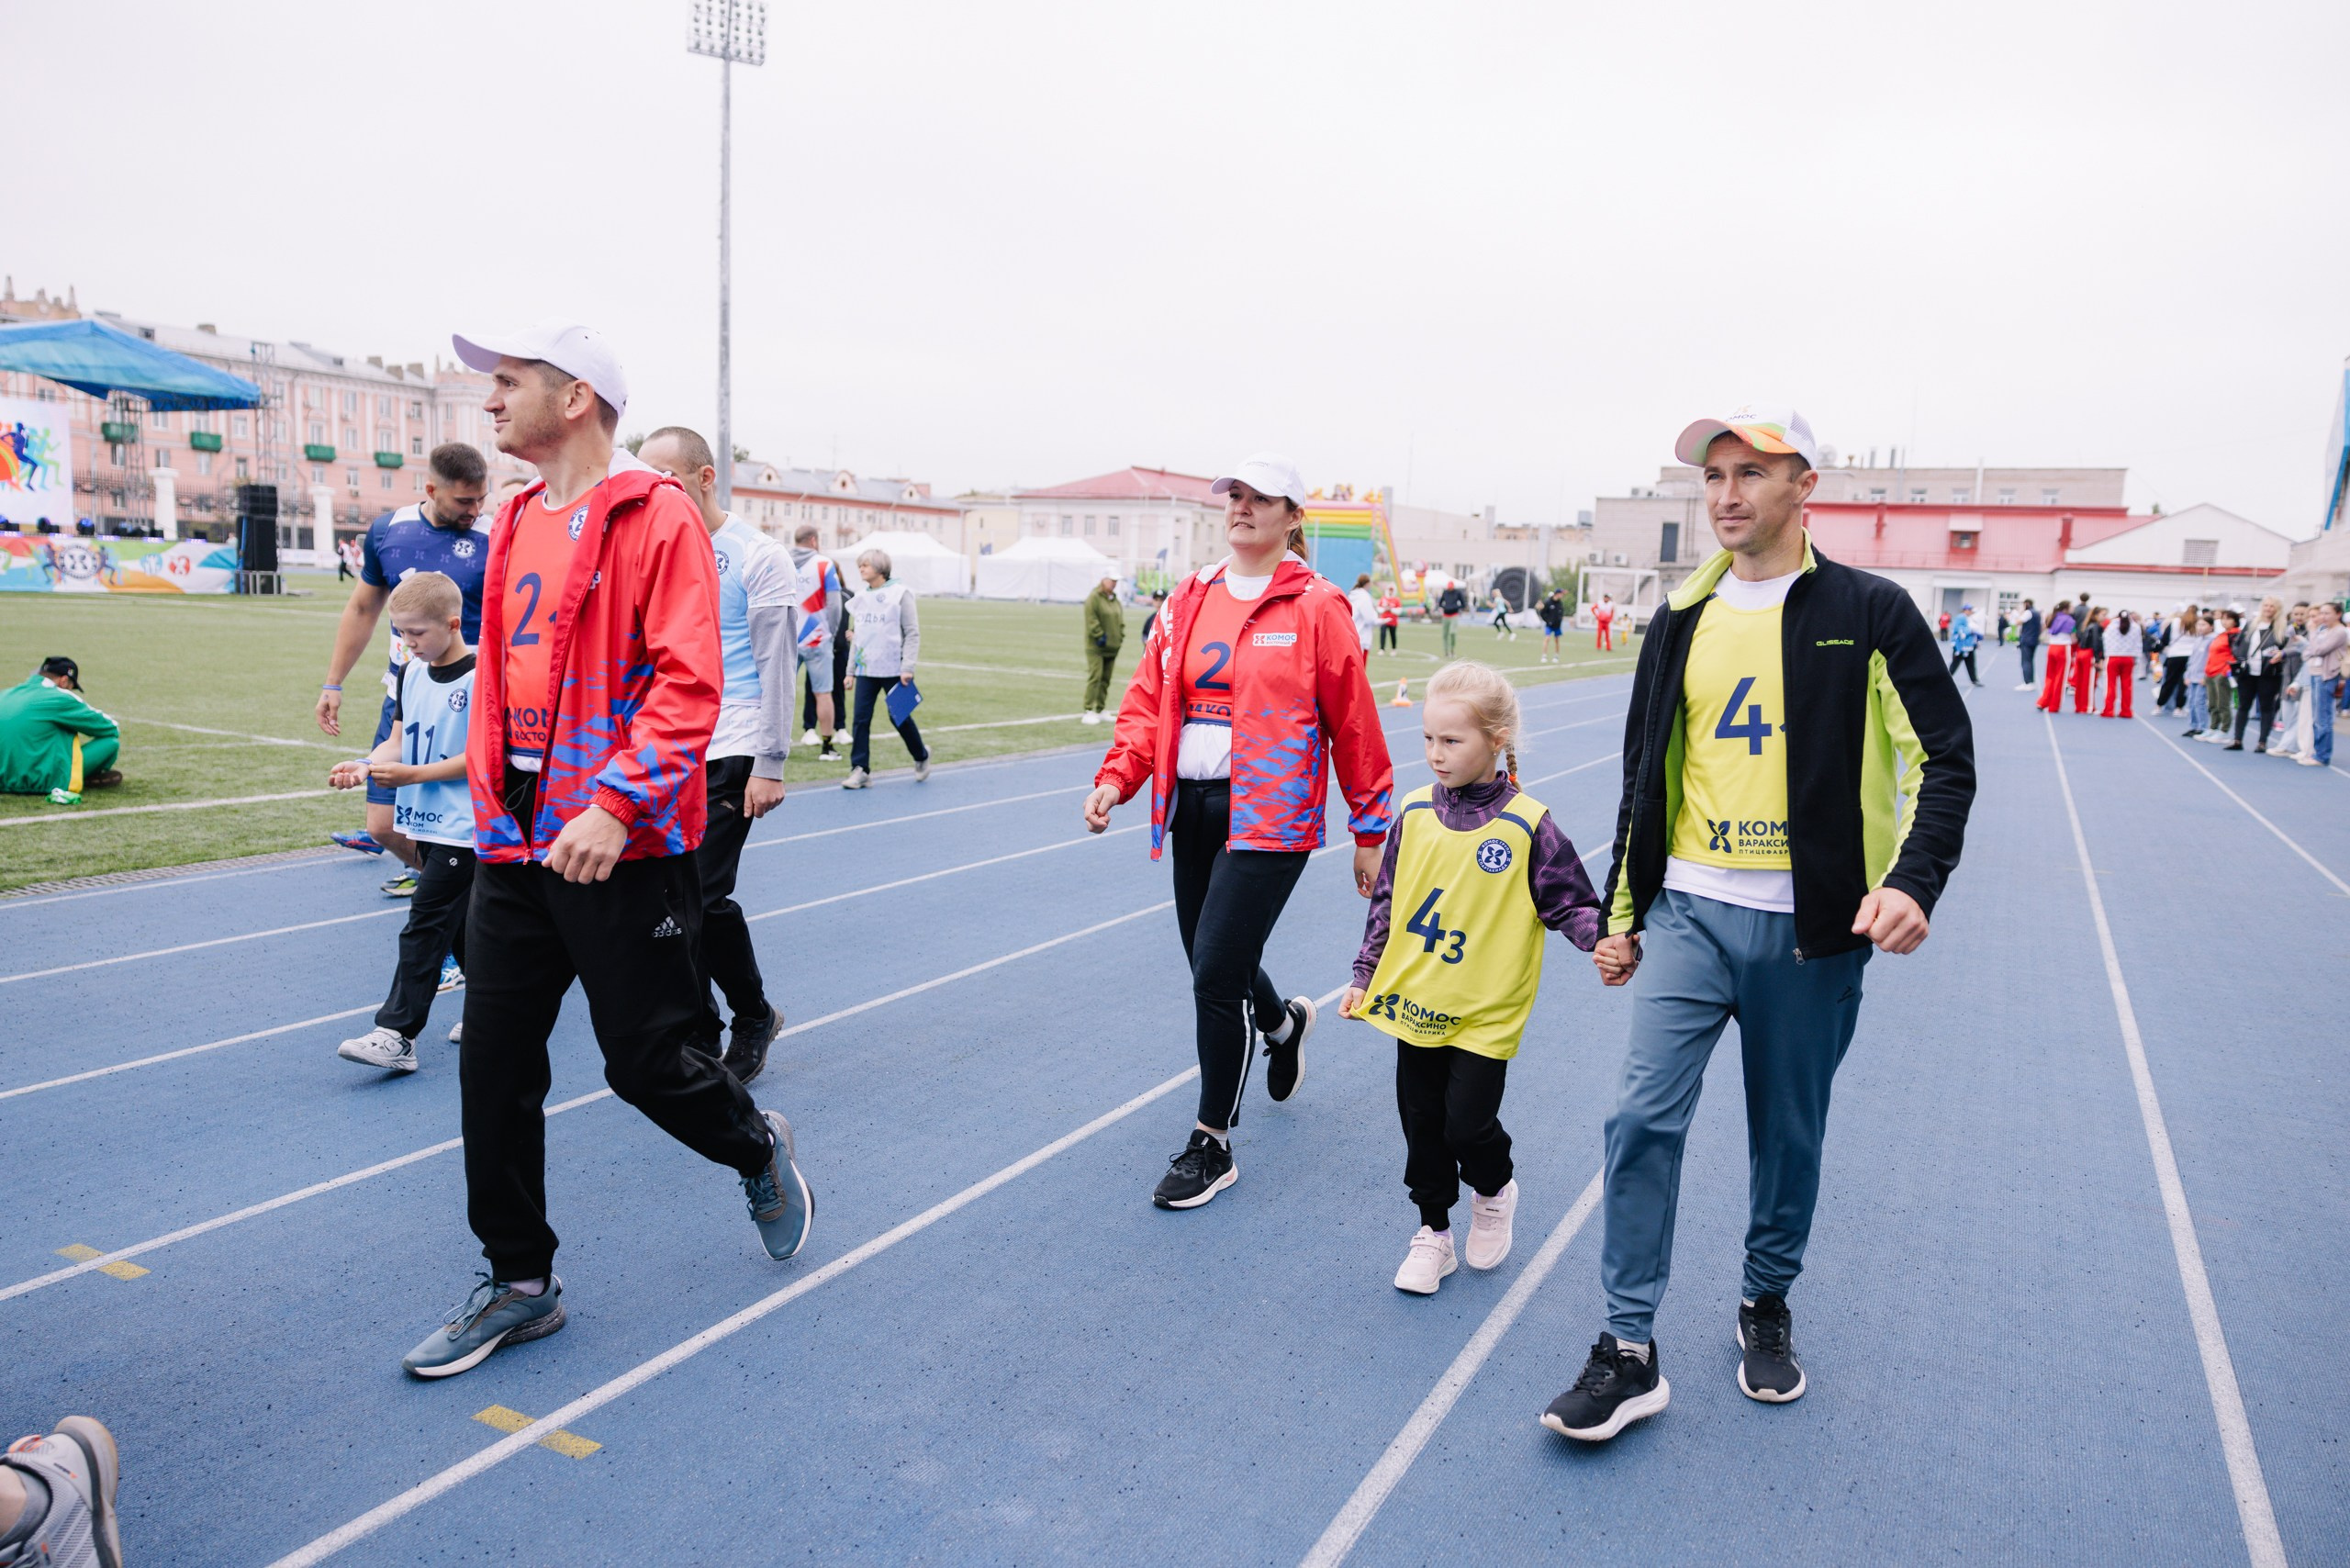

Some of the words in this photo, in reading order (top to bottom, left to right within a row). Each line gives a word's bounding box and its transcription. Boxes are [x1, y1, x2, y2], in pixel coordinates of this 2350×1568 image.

[1194, 641, 1231, 690] 2
[411, 811, 443, 823] МОС
[1401, 1012, 1447, 1030] ВАРАКСИНО
[1403, 998, 1461, 1025] КОМОС
